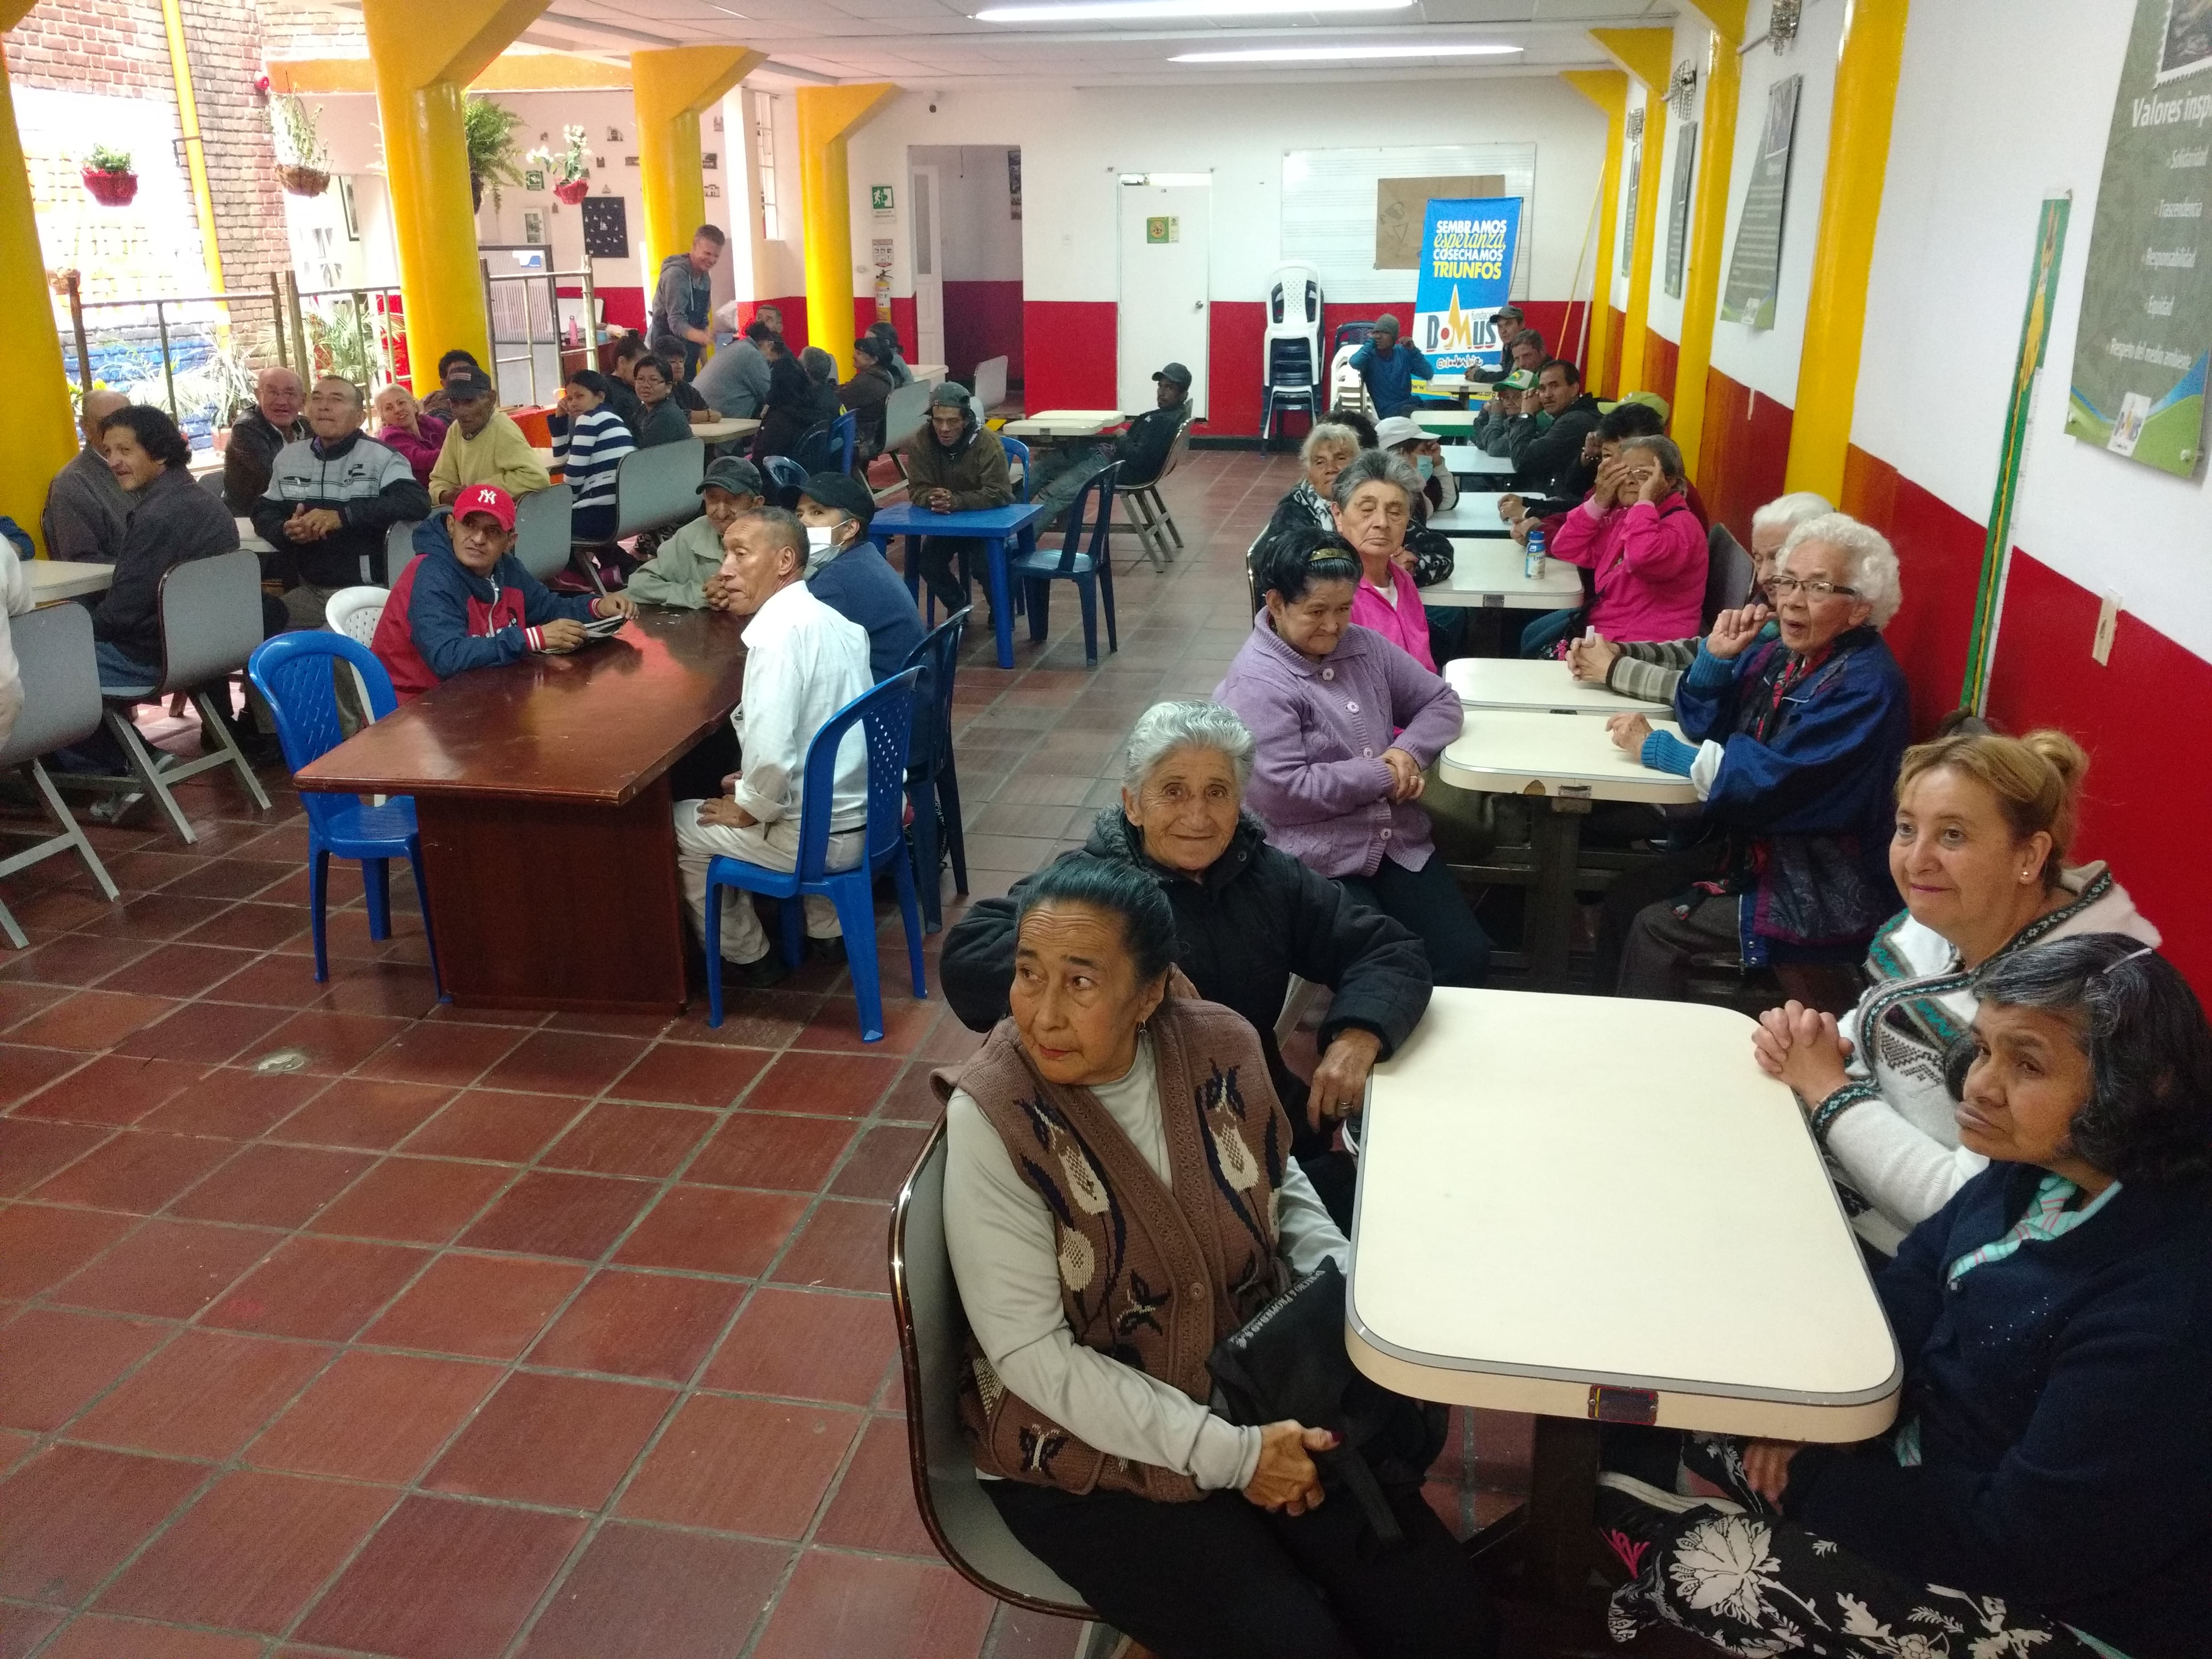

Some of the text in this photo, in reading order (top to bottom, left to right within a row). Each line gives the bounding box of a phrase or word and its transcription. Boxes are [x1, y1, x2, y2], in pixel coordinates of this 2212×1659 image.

[2133, 94, 2183, 127] Valores
[1436, 220, 1507, 233] SEMBRAMOS
[1433, 249, 1503, 262] COSECHAMOS
[1433, 261, 1502, 279] TRIUNFOS
[478, 489, 497, 505] NY
